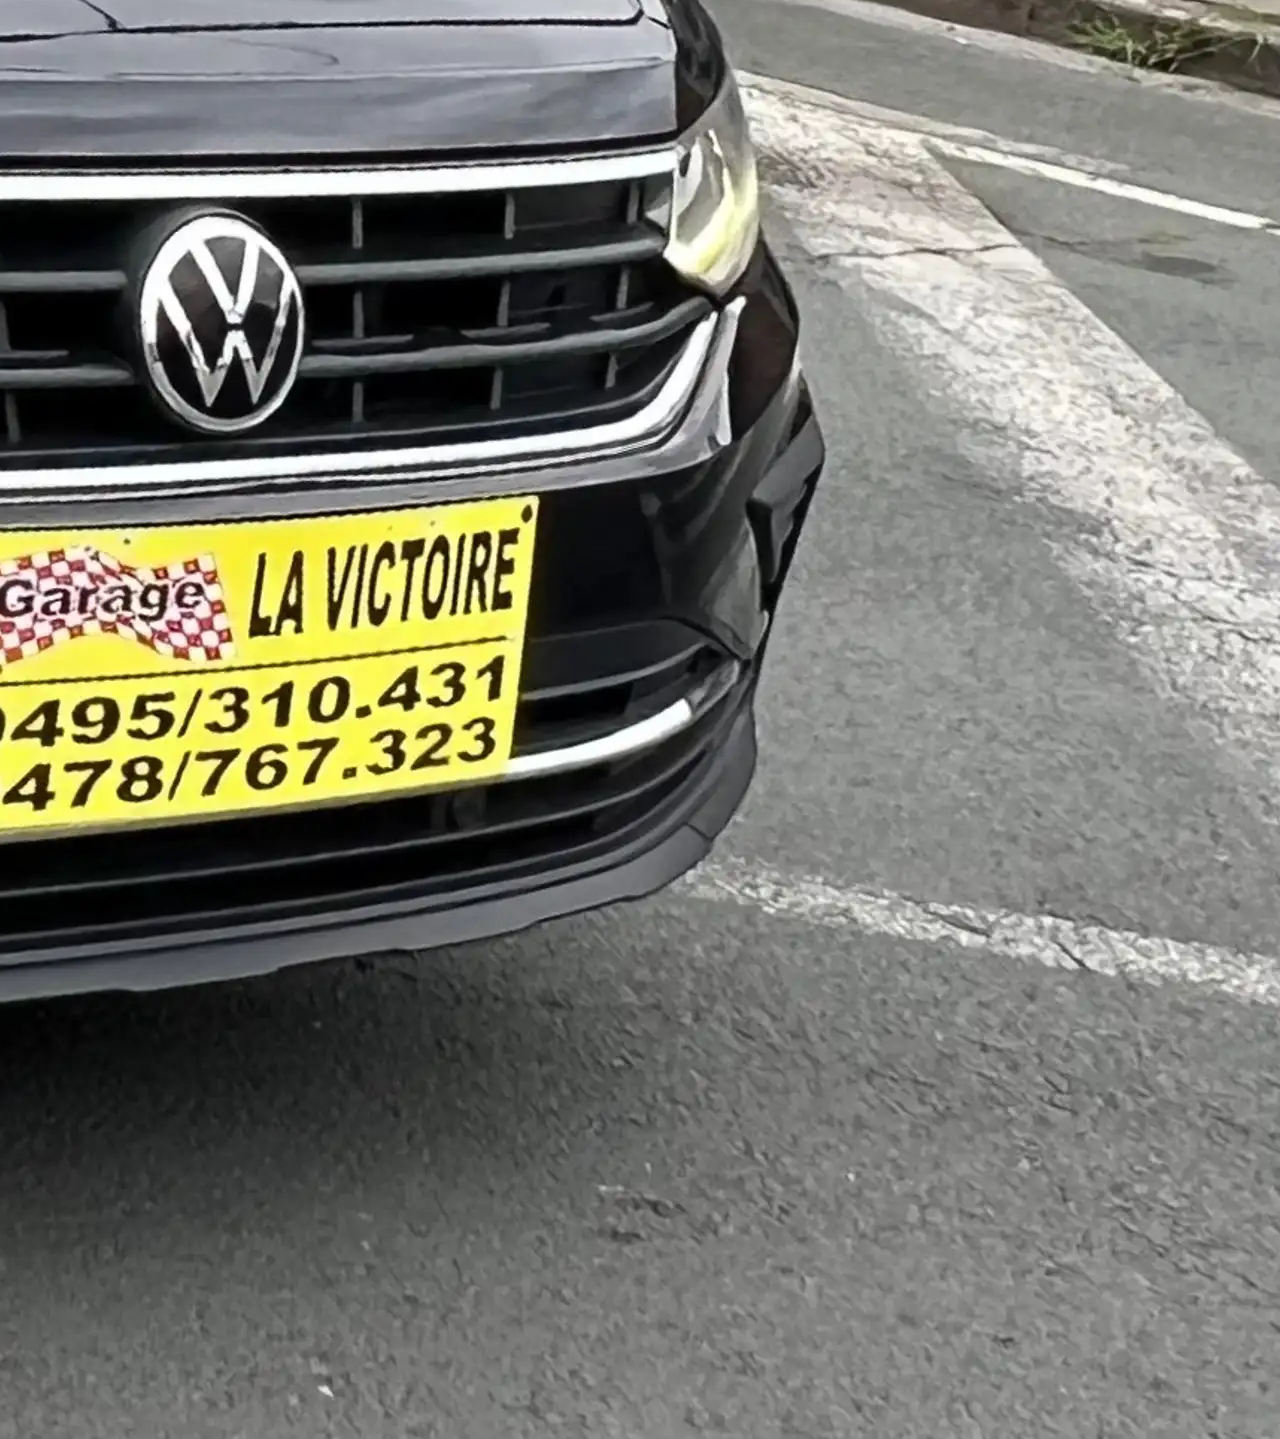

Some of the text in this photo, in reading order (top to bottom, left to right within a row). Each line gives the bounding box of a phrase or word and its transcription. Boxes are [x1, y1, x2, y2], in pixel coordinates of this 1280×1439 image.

[140, 216, 305, 432] VW
[248, 527, 521, 638] LA VICTOIRE
